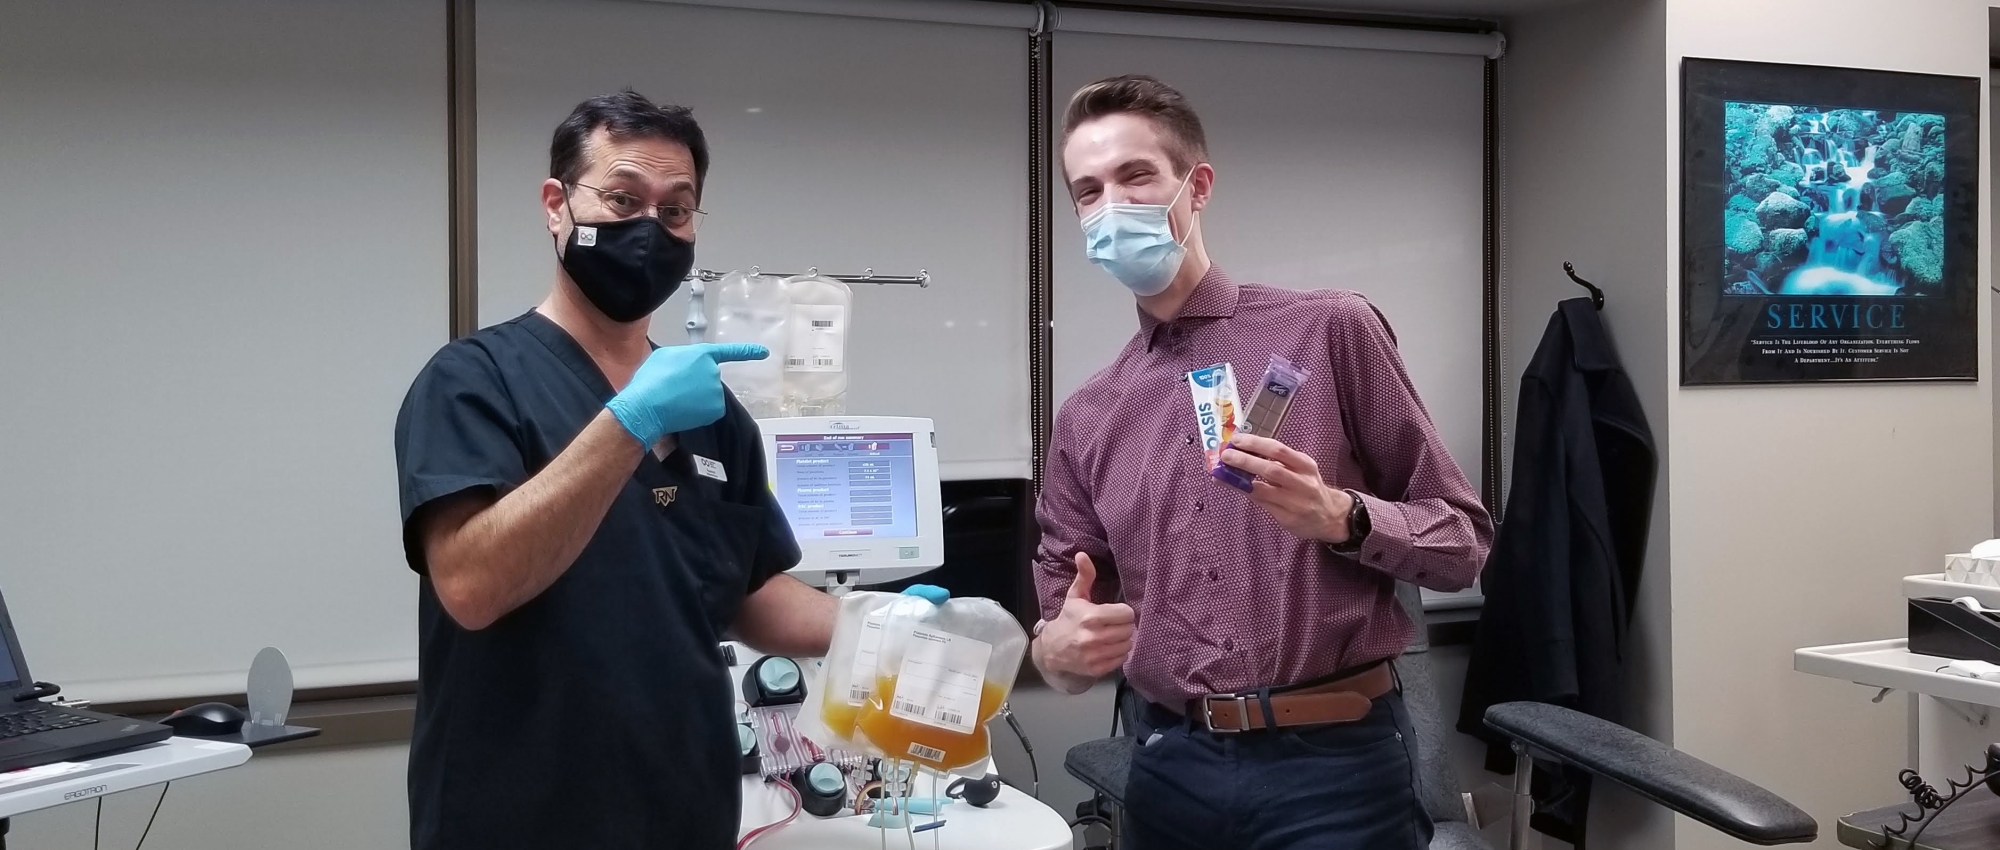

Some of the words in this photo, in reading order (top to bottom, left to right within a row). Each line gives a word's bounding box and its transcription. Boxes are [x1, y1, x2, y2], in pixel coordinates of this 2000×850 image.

[1767, 303, 1905, 329] SERVICE
[1198, 402, 1220, 450] OASIS
[655, 488, 676, 501] RN
[64, 784, 107, 800] ERGOTRON
